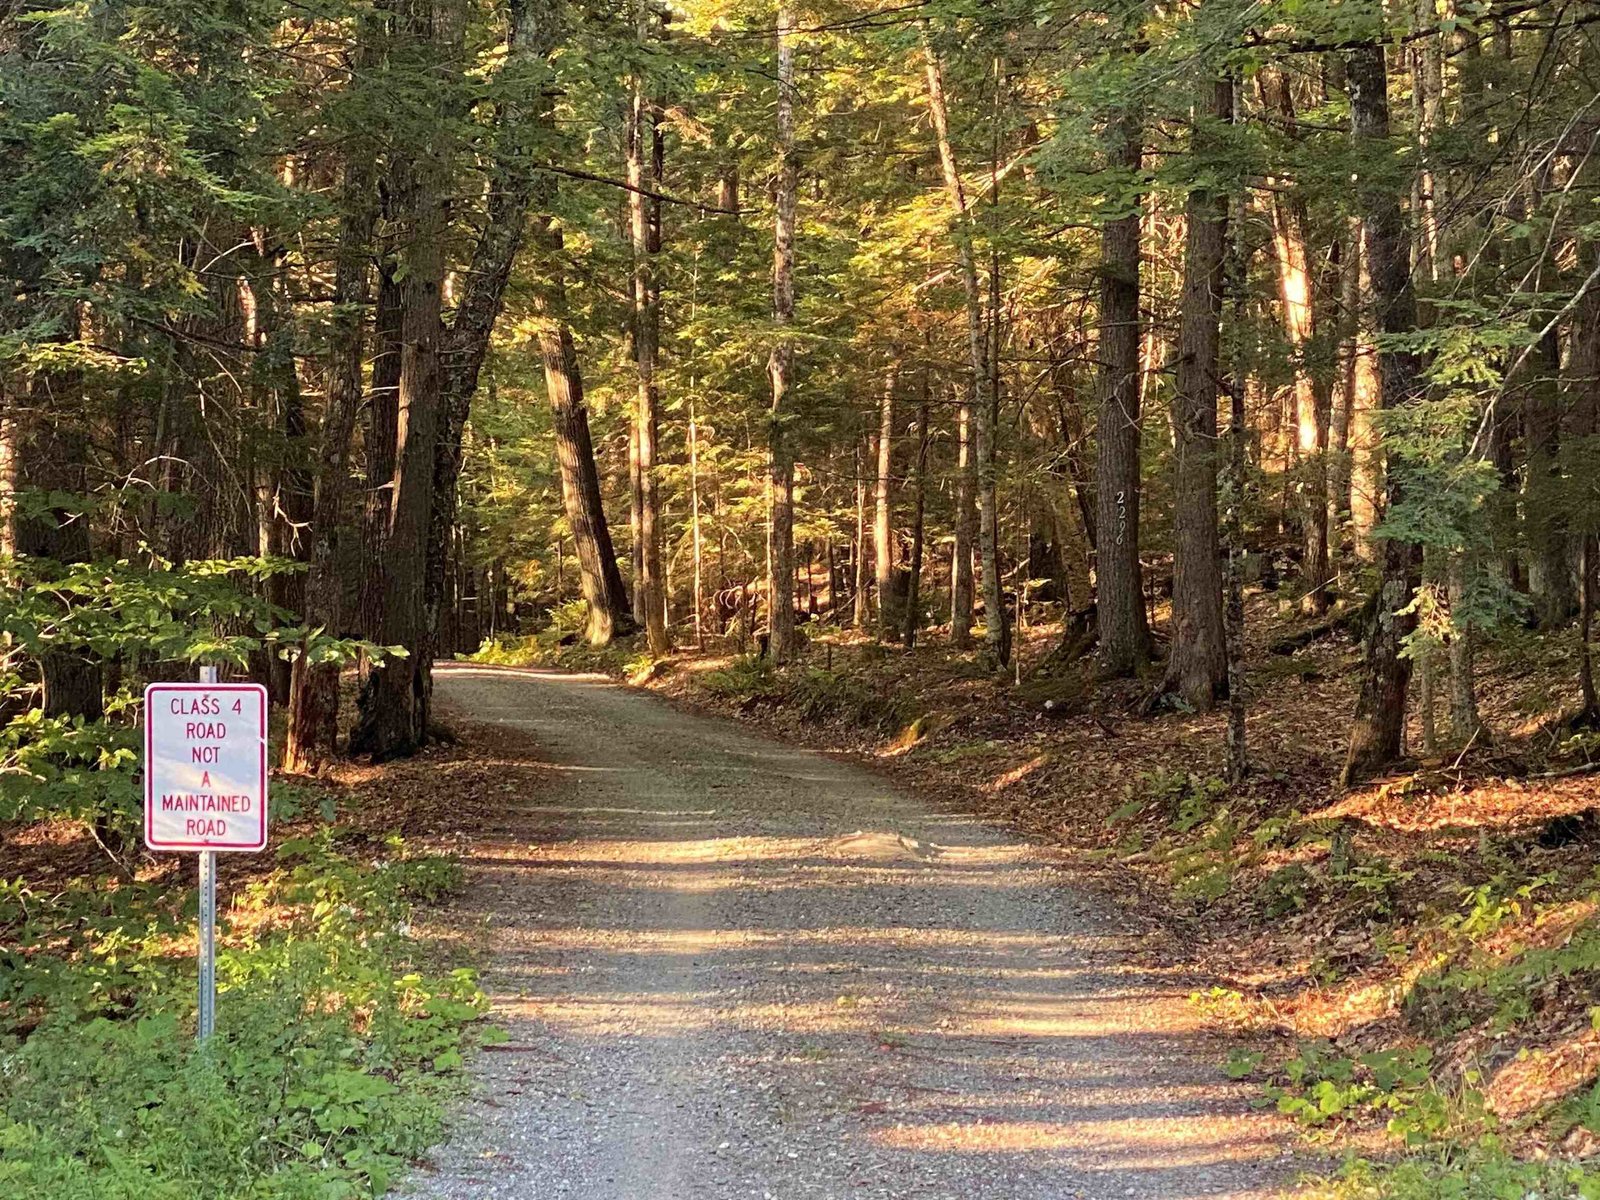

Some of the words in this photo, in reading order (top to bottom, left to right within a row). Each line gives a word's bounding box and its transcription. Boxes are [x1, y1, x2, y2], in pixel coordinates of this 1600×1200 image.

[170, 698, 220, 715] CLASS
[231, 698, 242, 715] 4
[186, 722, 226, 739] ROAD
[192, 747, 220, 763] NOT
[201, 771, 211, 788] A
[162, 795, 251, 812] MAINTAINED
[186, 819, 226, 836] ROAD
